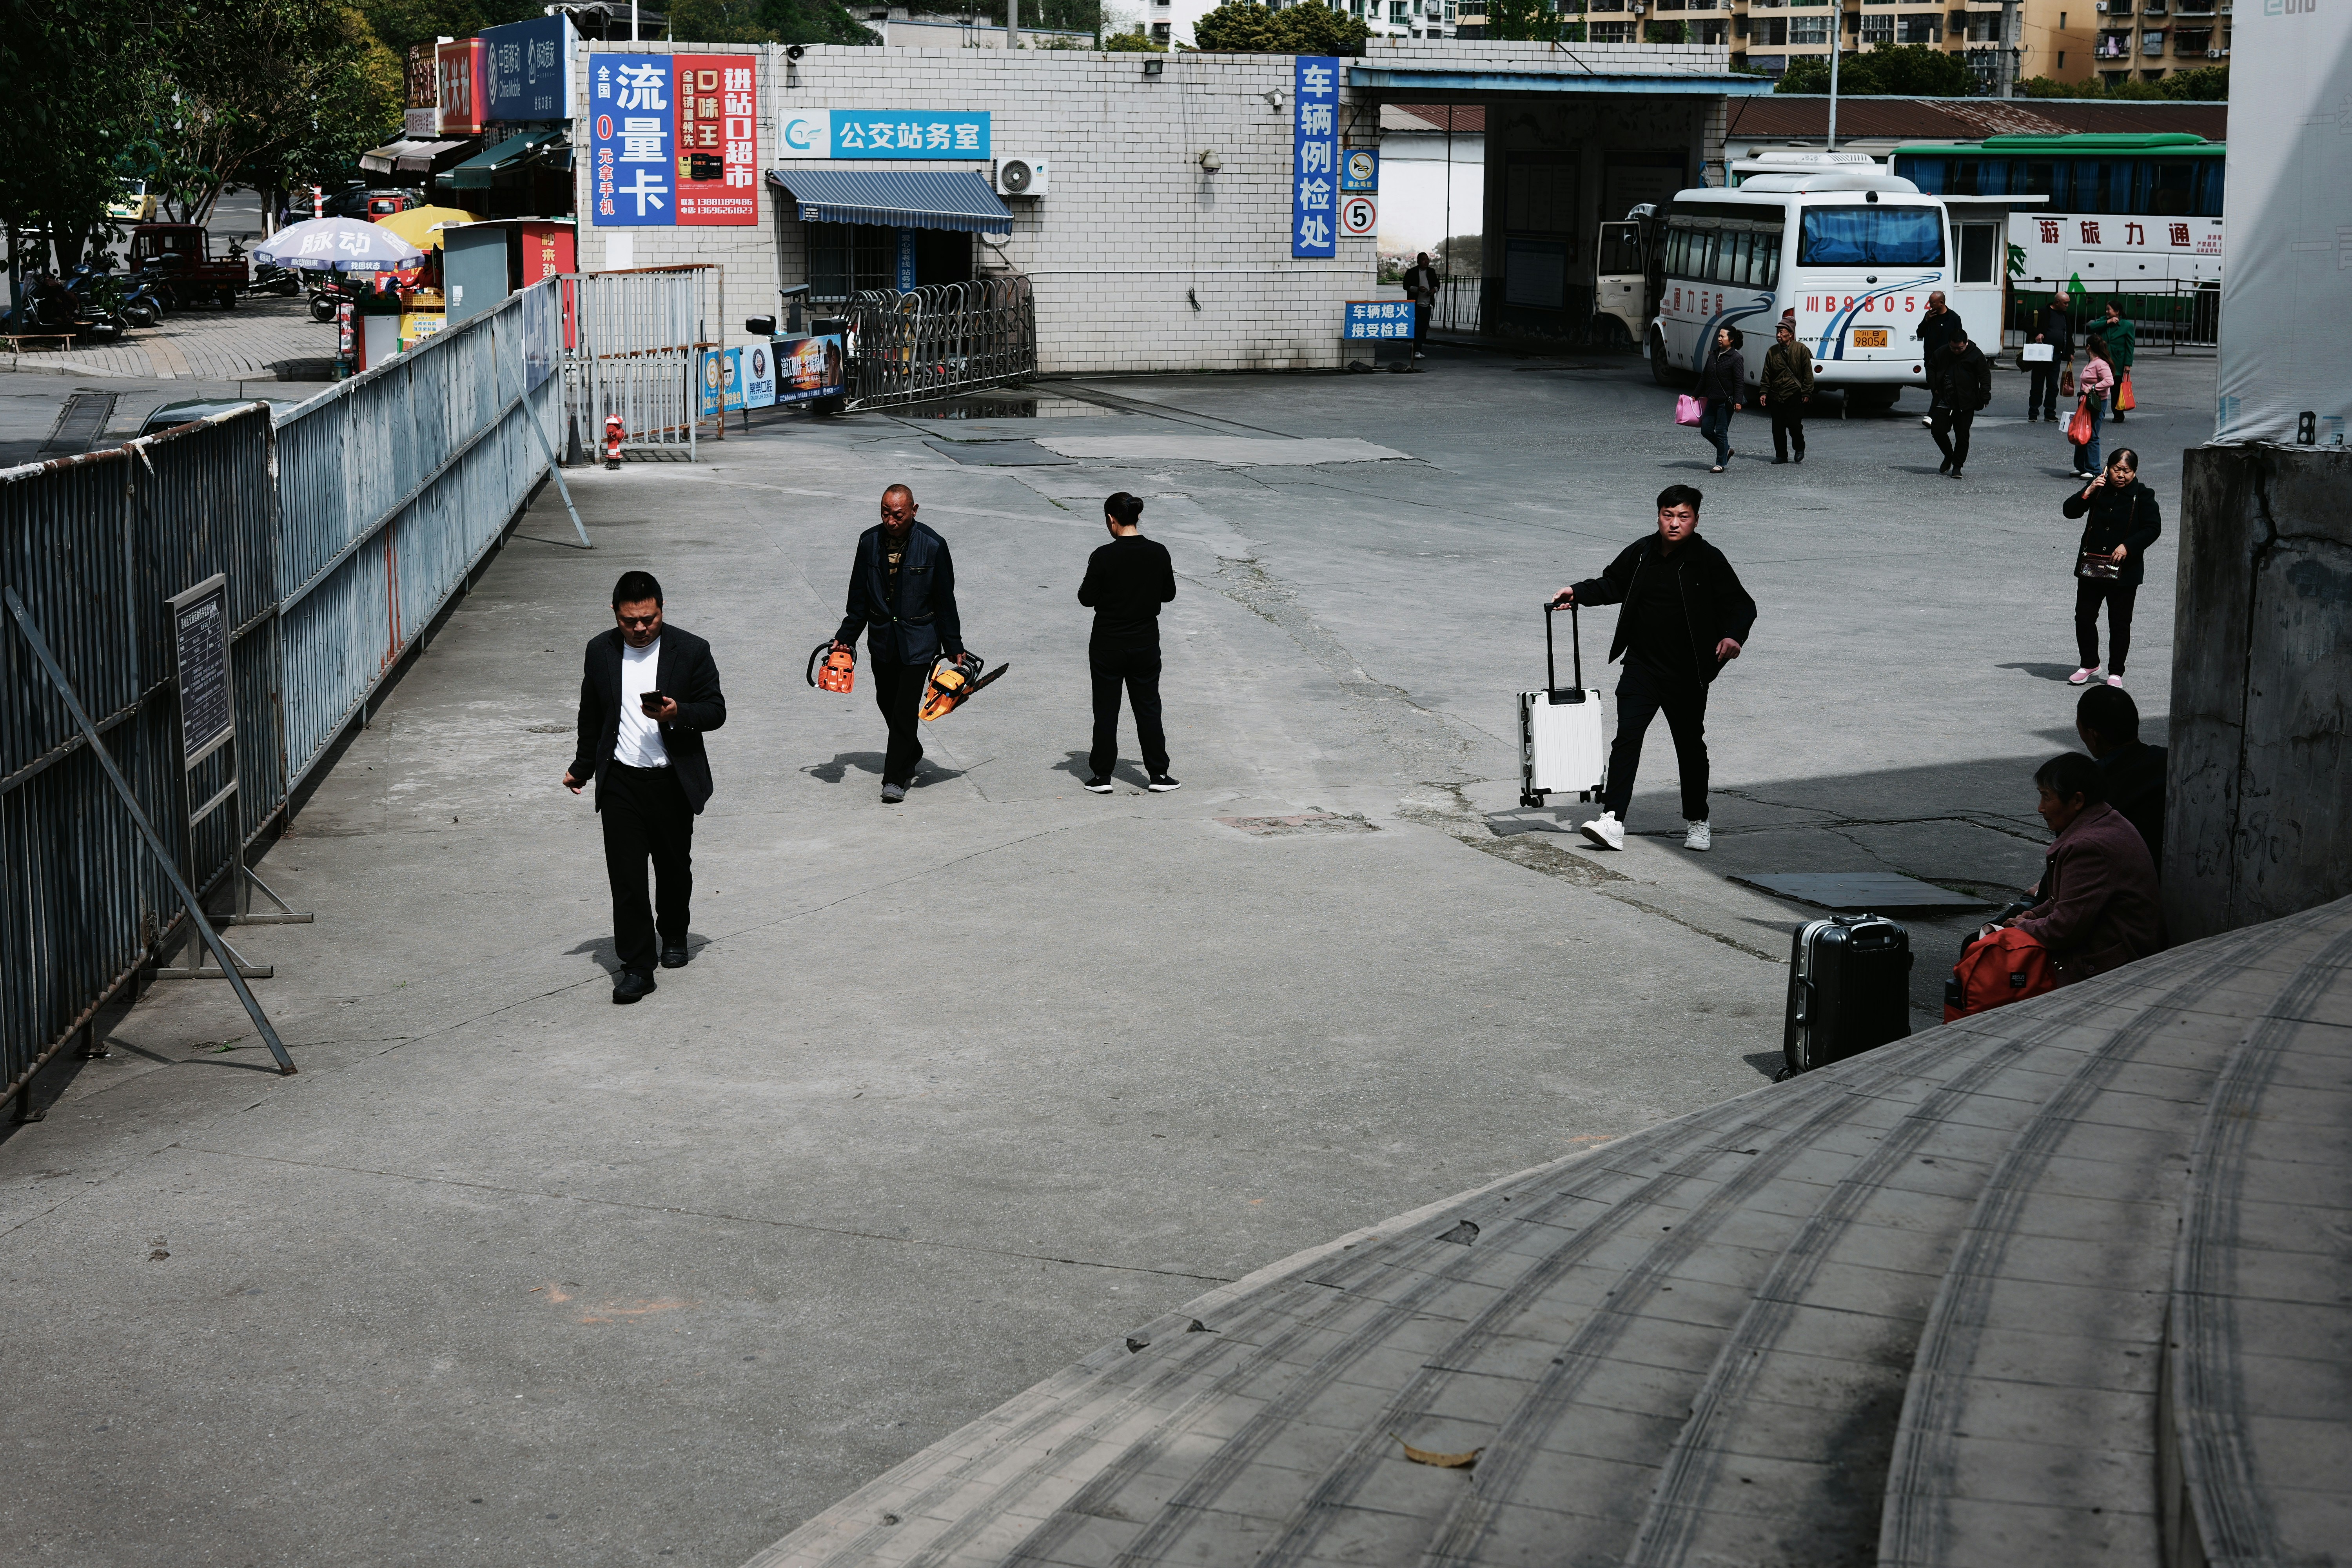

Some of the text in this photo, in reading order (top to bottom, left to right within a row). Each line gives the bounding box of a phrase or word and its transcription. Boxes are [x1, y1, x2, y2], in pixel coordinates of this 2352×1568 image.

[499, 41, 520, 74] 中国移动
[499, 78, 520, 98] China Mobile
[597, 65, 610, 98] 全国
[682, 70, 694, 146] 全国销量领先
[697, 70, 719, 147] 口味王
[616, 64, 668, 216] 流量卡
[724, 68, 753, 188] 进站口超市
[840, 122, 980, 149] 公交站务室
[1299, 64, 1332, 248] 车辆例检处
[1353, 206, 1367, 227] 5
[298, 231, 370, 256] 脉动
[541, 233, 556, 276] 秒来劲
[902, 235, 910, 267] 爱心敬老线
[291, 258, 318, 267] 脉动回来
[351, 262, 380, 270] 找回状态
[902, 269, 910, 289] 站务室
[1353, 304, 1408, 319] 车辆熄火
[1673, 288, 1723, 318] 通力运输
[1351, 322, 1408, 337] 接受检查
[1855, 337, 1886, 347] 98054
[710, 365, 715, 382] 5
